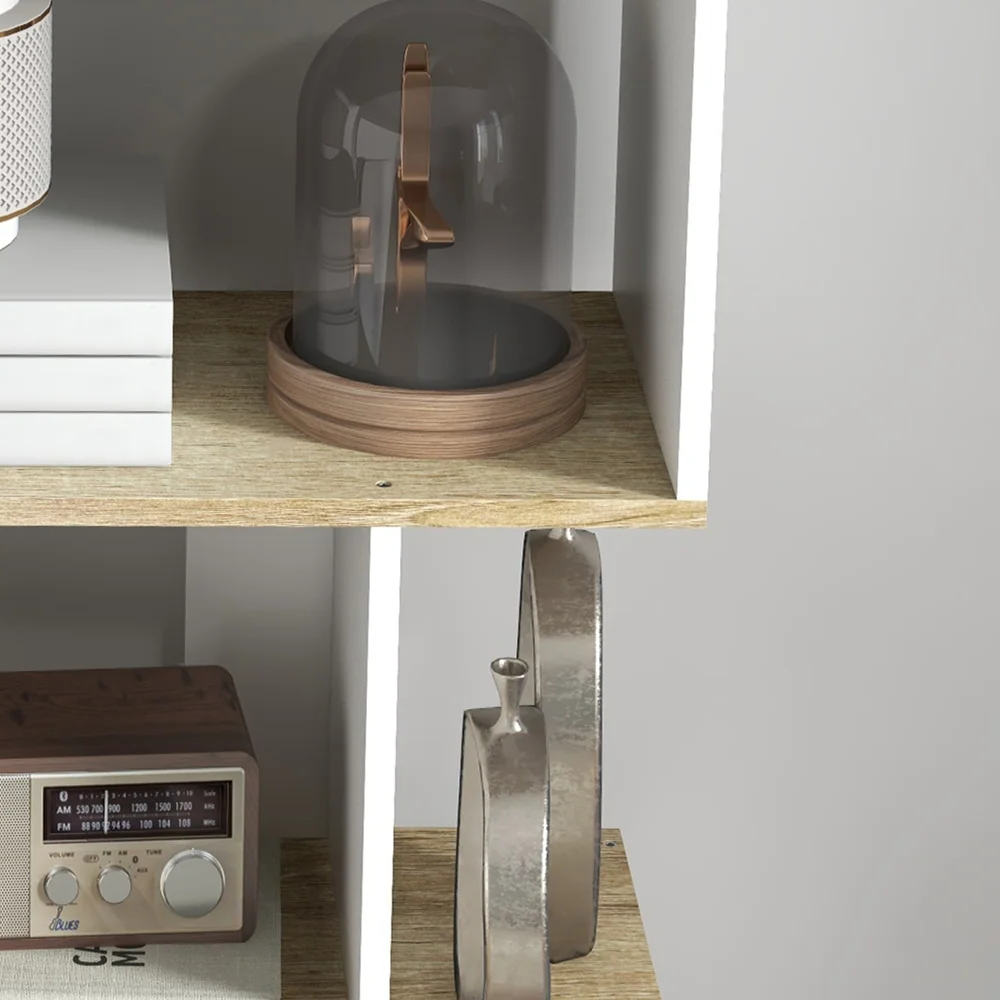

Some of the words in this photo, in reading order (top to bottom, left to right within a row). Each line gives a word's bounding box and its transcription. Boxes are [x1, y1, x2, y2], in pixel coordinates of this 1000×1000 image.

[56, 805, 71, 814] AM
[76, 805, 89, 814] 530
[91, 804, 103, 813] 700
[108, 804, 121, 813] 900
[131, 803, 148, 812] 1200
[155, 802, 172, 811] 1500
[175, 801, 193, 811] 1700
[57, 822, 71, 831] FM
[81, 821, 90, 831] 88
[91, 821, 100, 830] 90
[112, 820, 120, 830] 94
[121, 820, 131, 830] 96
[140, 820, 153, 829] 100
[158, 819, 171, 828] 104
[178, 818, 191, 828] 108
